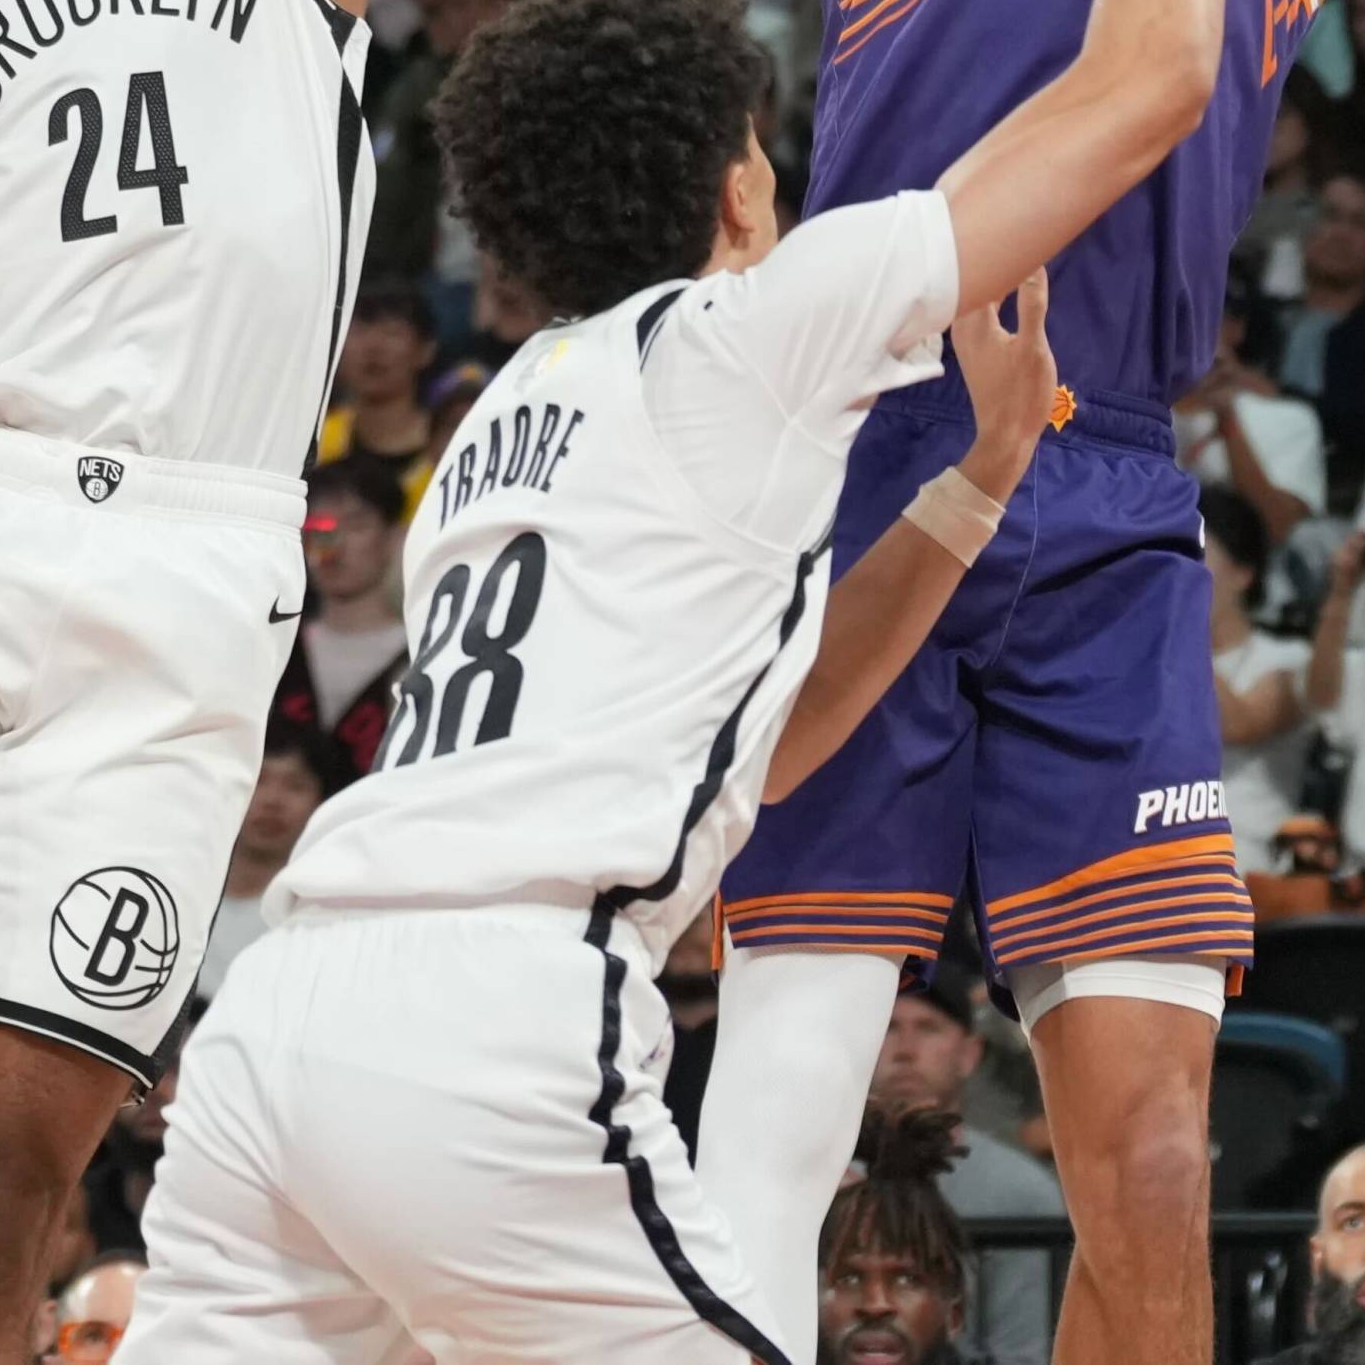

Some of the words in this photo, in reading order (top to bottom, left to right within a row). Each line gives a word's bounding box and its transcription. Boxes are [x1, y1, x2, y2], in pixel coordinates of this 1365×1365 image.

[47, 71, 189, 242] 24
[79, 458, 121, 483] NETS
[439, 403, 585, 530] TRAORE
[371, 531, 547, 773] 88
[84, 887, 149, 987] B
